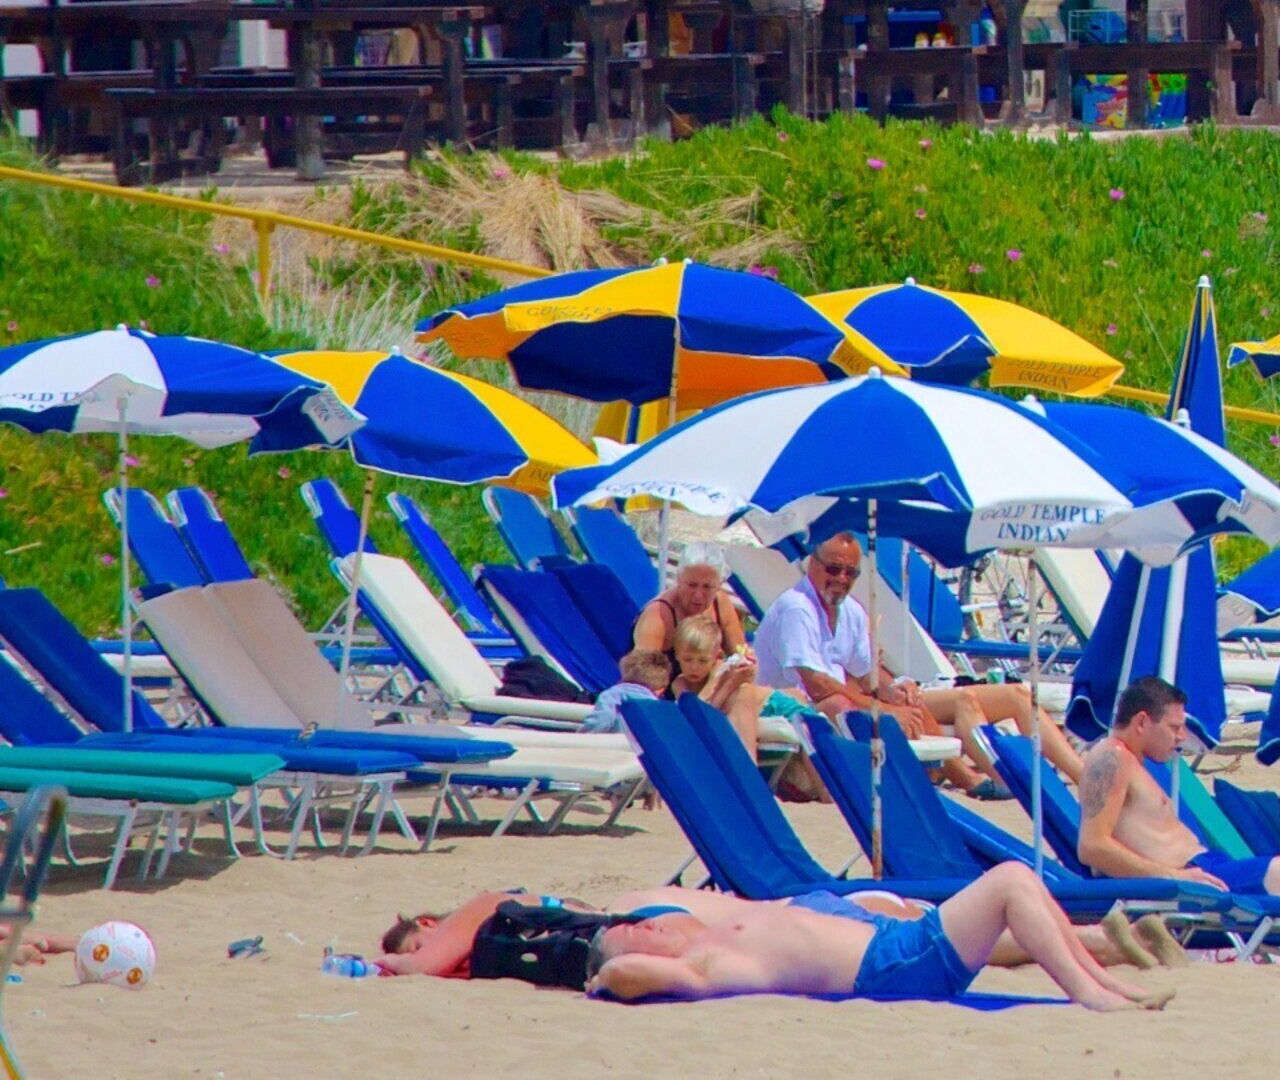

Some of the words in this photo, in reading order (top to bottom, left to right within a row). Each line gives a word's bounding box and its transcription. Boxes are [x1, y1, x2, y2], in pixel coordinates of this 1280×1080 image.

[1051, 360, 1101, 379] TEMPLE
[1018, 370, 1072, 390] INDIAN
[9, 391, 54, 402] OLD
[981, 505, 1026, 520] GOLD
[1031, 503, 1105, 525] TEMPLE
[997, 522, 1070, 542] INDIAN
